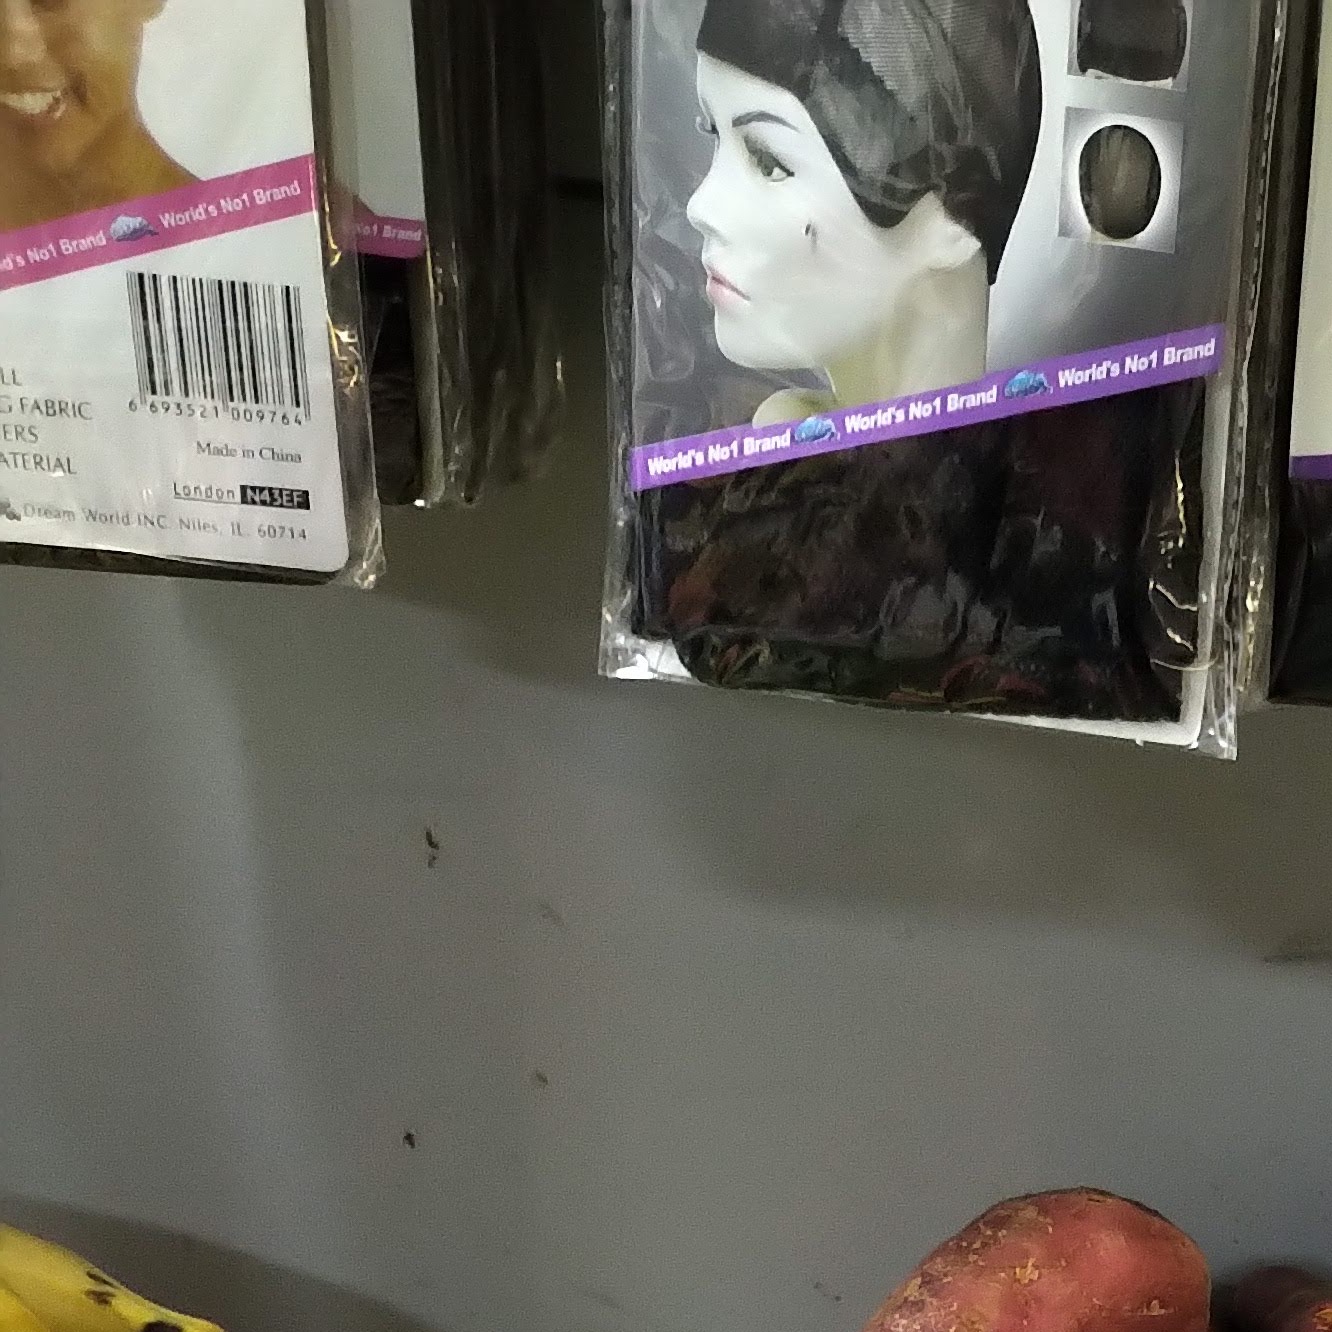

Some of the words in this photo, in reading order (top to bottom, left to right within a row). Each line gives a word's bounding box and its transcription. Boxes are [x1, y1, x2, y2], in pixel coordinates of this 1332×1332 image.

[159, 201, 218, 229] World's
[219, 193, 250, 215] No1
[251, 180, 301, 207] Brand
[26, 243, 57, 264] No1
[59, 230, 107, 255] Brand
[1057, 359, 1121, 389] World's
[1124, 350, 1158, 375] No1
[1163, 337, 1217, 367] Brand
[19, 396, 93, 421] FABRIC
[149, 401, 219, 419] 693521
[231, 406, 302, 426] 009764
[845, 406, 905, 434] World's
[908, 396, 942, 422] No1
[946, 385, 998, 413] Brand
[196, 440, 238, 459] Made
[240, 446, 255, 460] in
[258, 448, 302, 464] China
[648, 449, 704, 476] World's
[707, 441, 738, 463] No1
[743, 429, 792, 456] Brand
[173, 482, 235, 500] London
[23, 502, 75, 522] Dream
[84, 507, 131, 526] World
[257, 525, 307, 541] 60714
